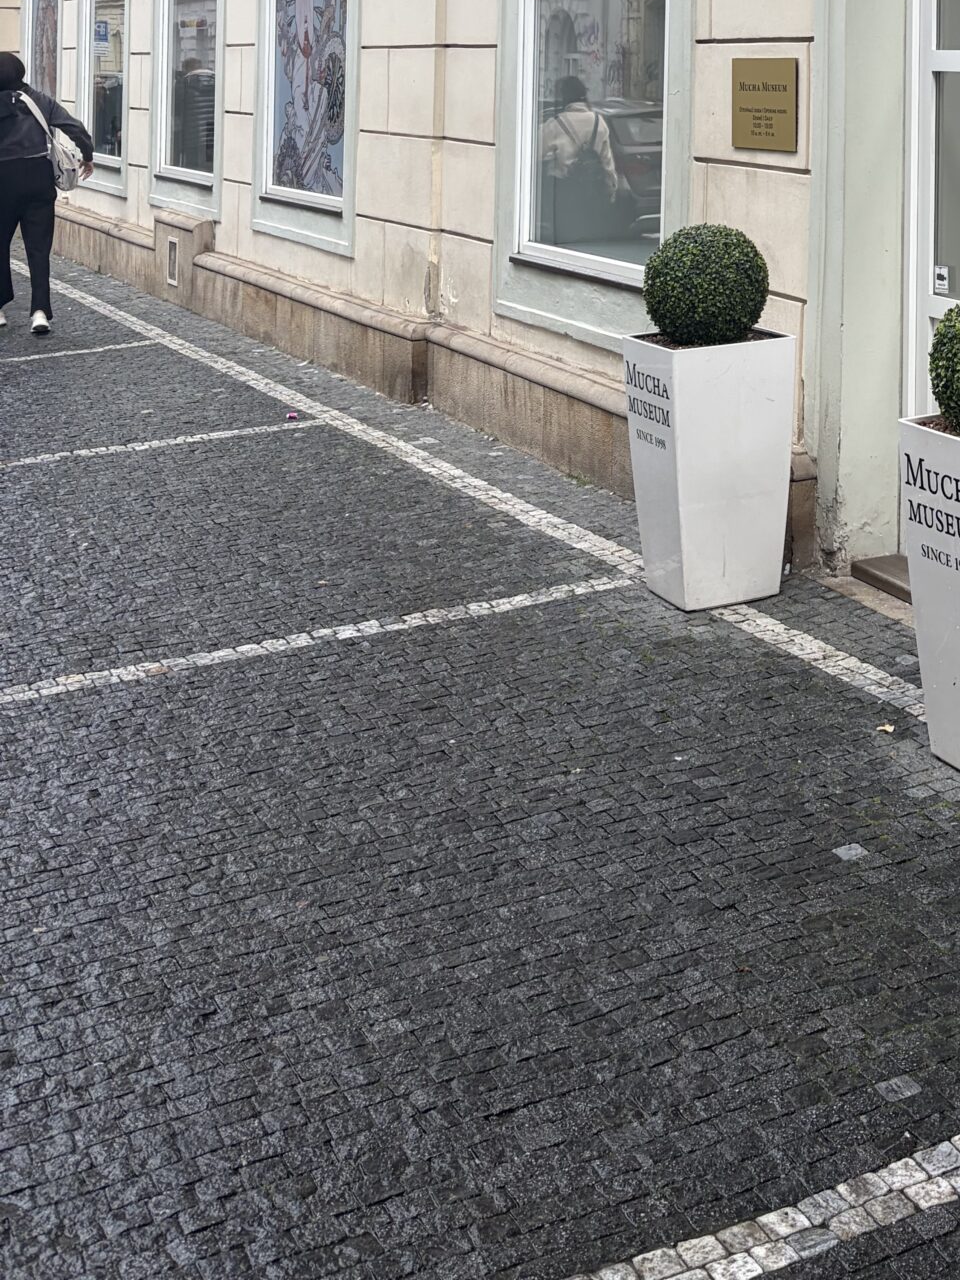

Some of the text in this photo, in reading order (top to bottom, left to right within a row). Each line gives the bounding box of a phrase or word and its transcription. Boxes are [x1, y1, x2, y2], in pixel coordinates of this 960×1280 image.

[738, 81, 788, 93] MUCHA MUSEUM
[625, 360, 671, 401] MUCHA
[628, 395, 671, 428] MUSEUM
[636, 428, 667, 450] SINCE 1998
[920, 543, 953, 568] SINCE
